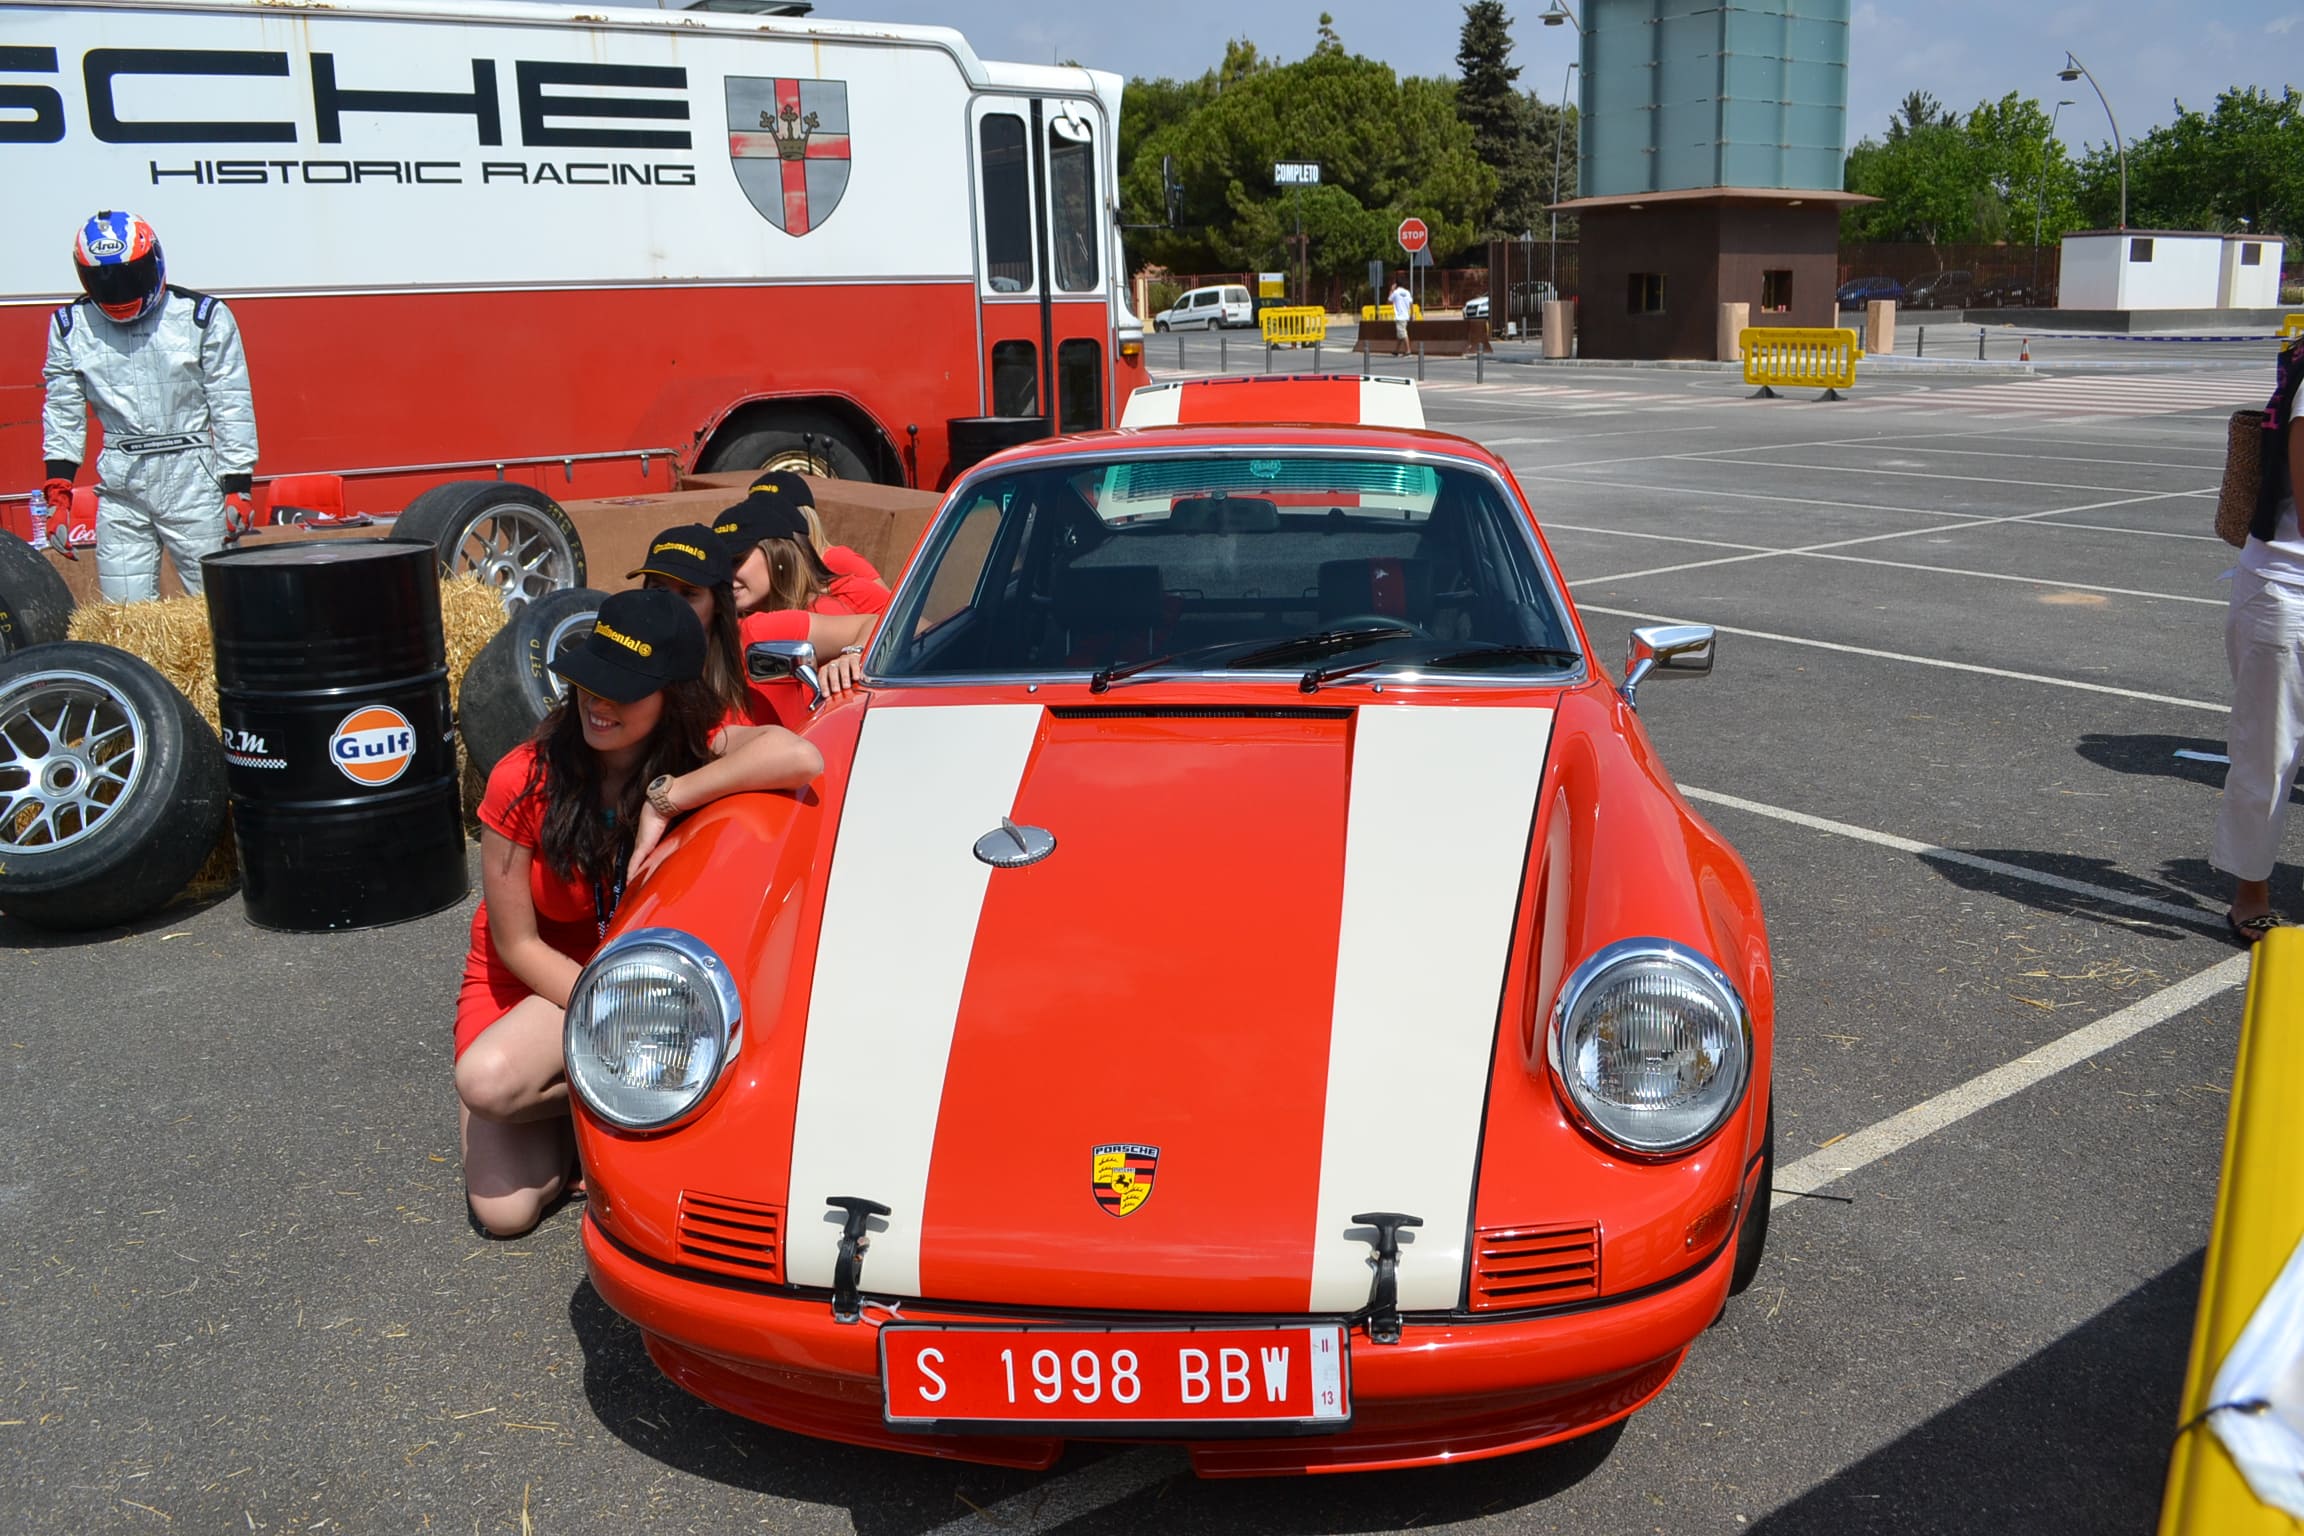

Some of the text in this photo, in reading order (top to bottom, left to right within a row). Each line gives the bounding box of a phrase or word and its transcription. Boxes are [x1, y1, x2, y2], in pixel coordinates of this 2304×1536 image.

[150, 160, 696, 187] HISTORIC RACING
[1275, 164, 1319, 183] COMPLETO
[1402, 231, 1425, 240] STOP
[93, 239, 120, 251] Arai
[335, 731, 411, 760] Gulf
[1095, 1145, 1157, 1157] PORSCHE
[916, 1346, 1290, 1404] S 1998 BBW
[1321, 1391, 1334, 1406] 13
